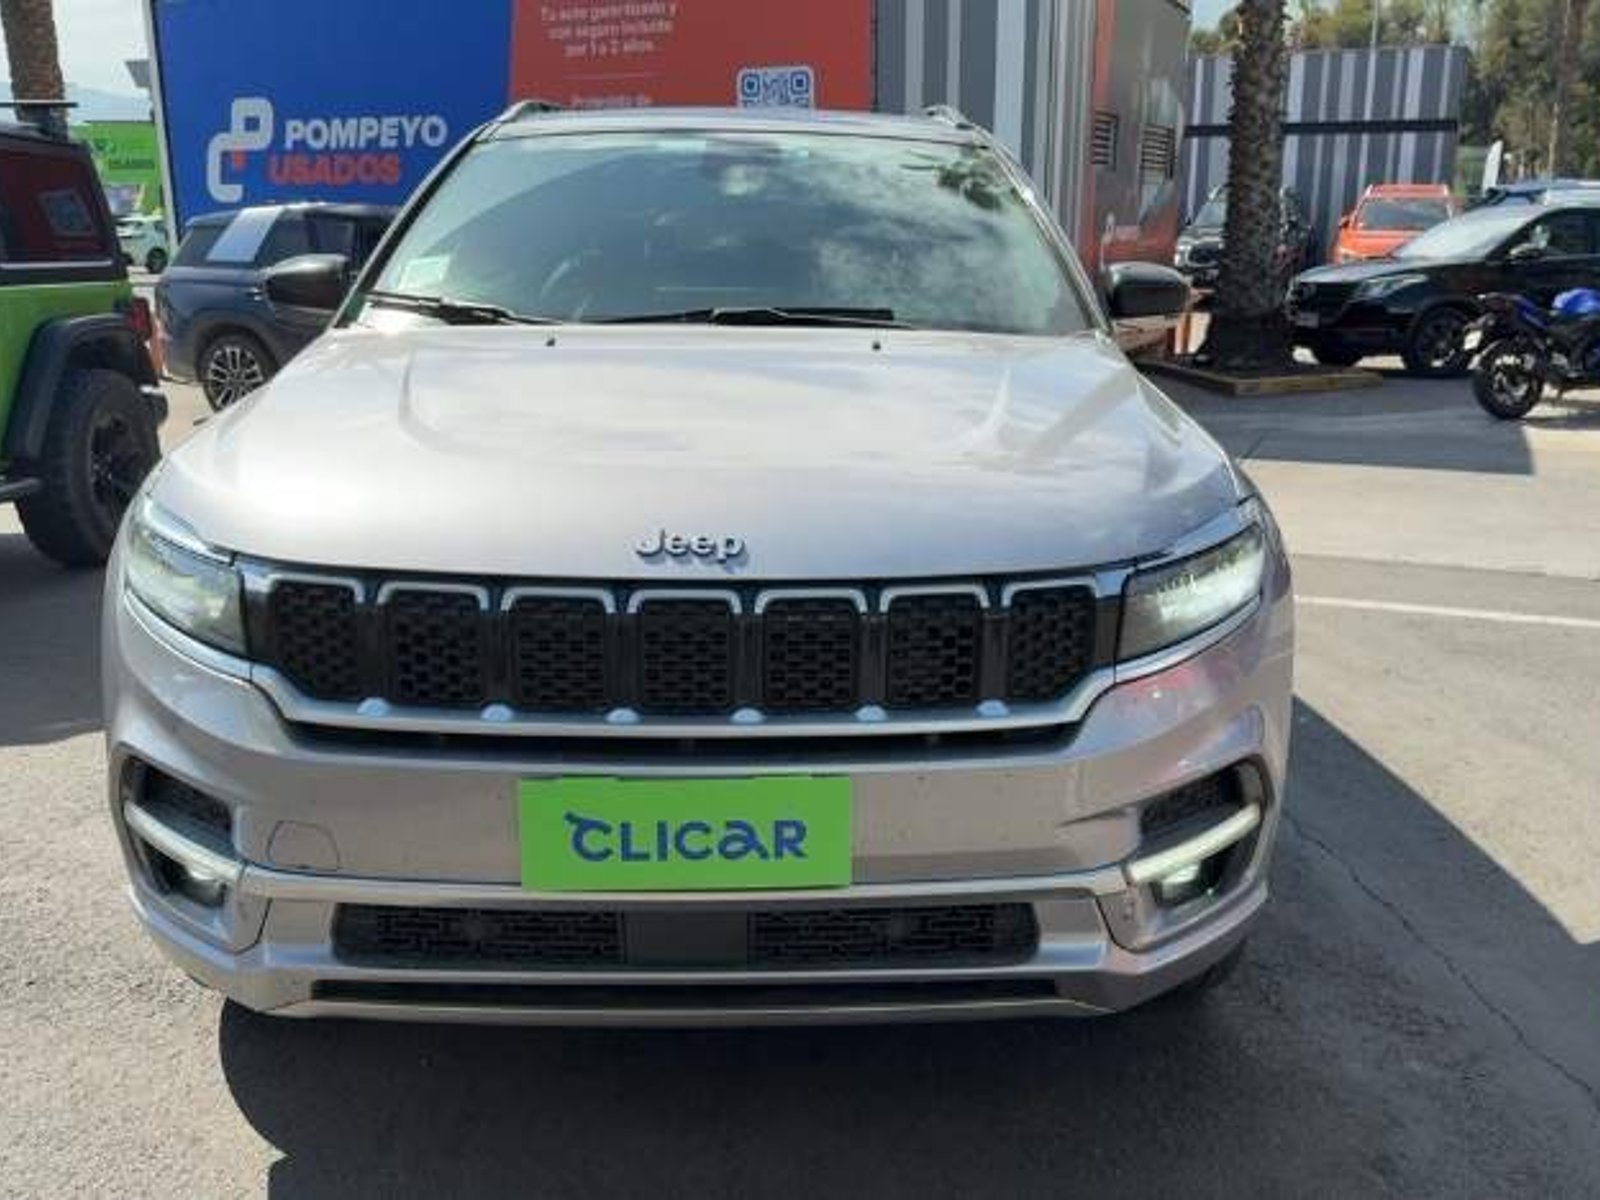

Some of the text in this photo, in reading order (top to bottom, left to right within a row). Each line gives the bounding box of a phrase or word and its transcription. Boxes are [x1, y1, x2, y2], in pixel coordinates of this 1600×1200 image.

[284, 115, 449, 150] POMPEYO
[268, 153, 402, 186] USADOS
[636, 528, 745, 564] Jeep
